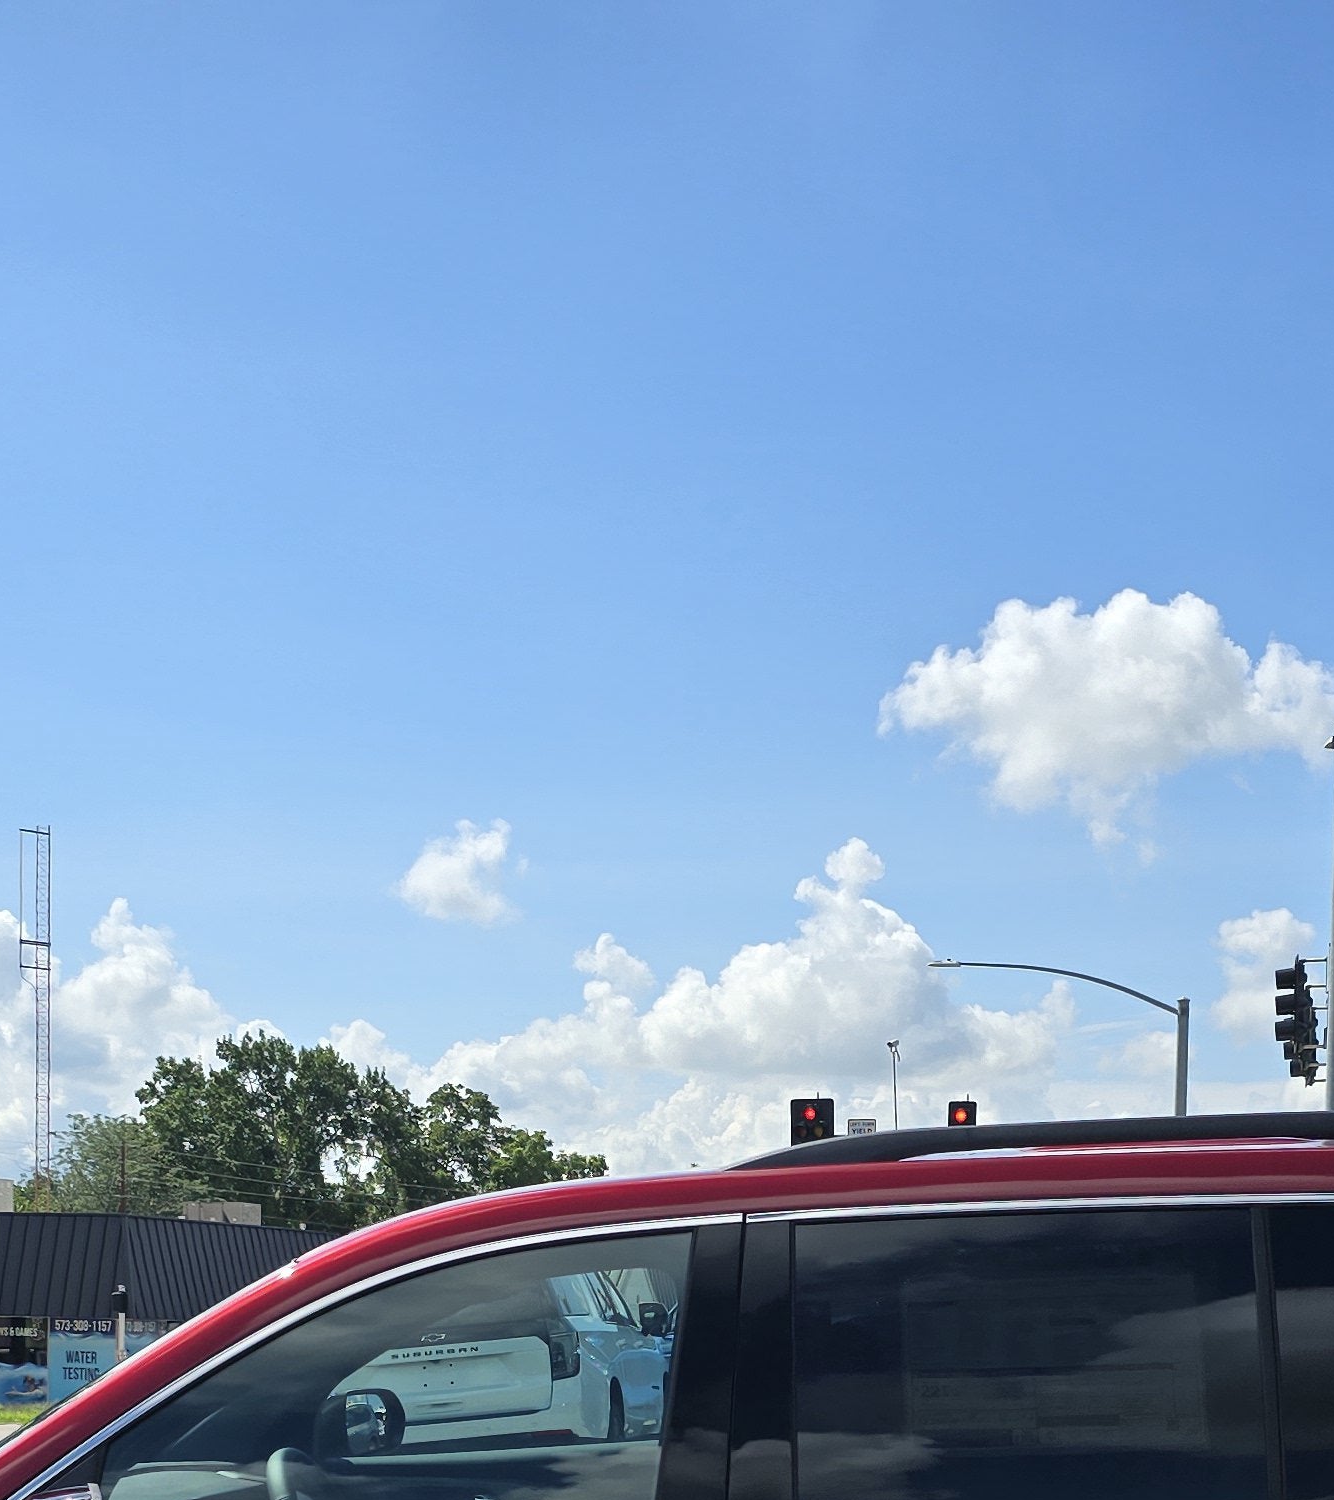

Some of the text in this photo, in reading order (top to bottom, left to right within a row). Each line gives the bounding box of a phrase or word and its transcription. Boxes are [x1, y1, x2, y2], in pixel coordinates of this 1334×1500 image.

[15, 1326, 38, 1337] GAMES
[55, 1319, 112, 1332] 573-308-1157
[66, 1350, 97, 1365] WATER
[391, 1346, 480, 1360] SUBURBAN
